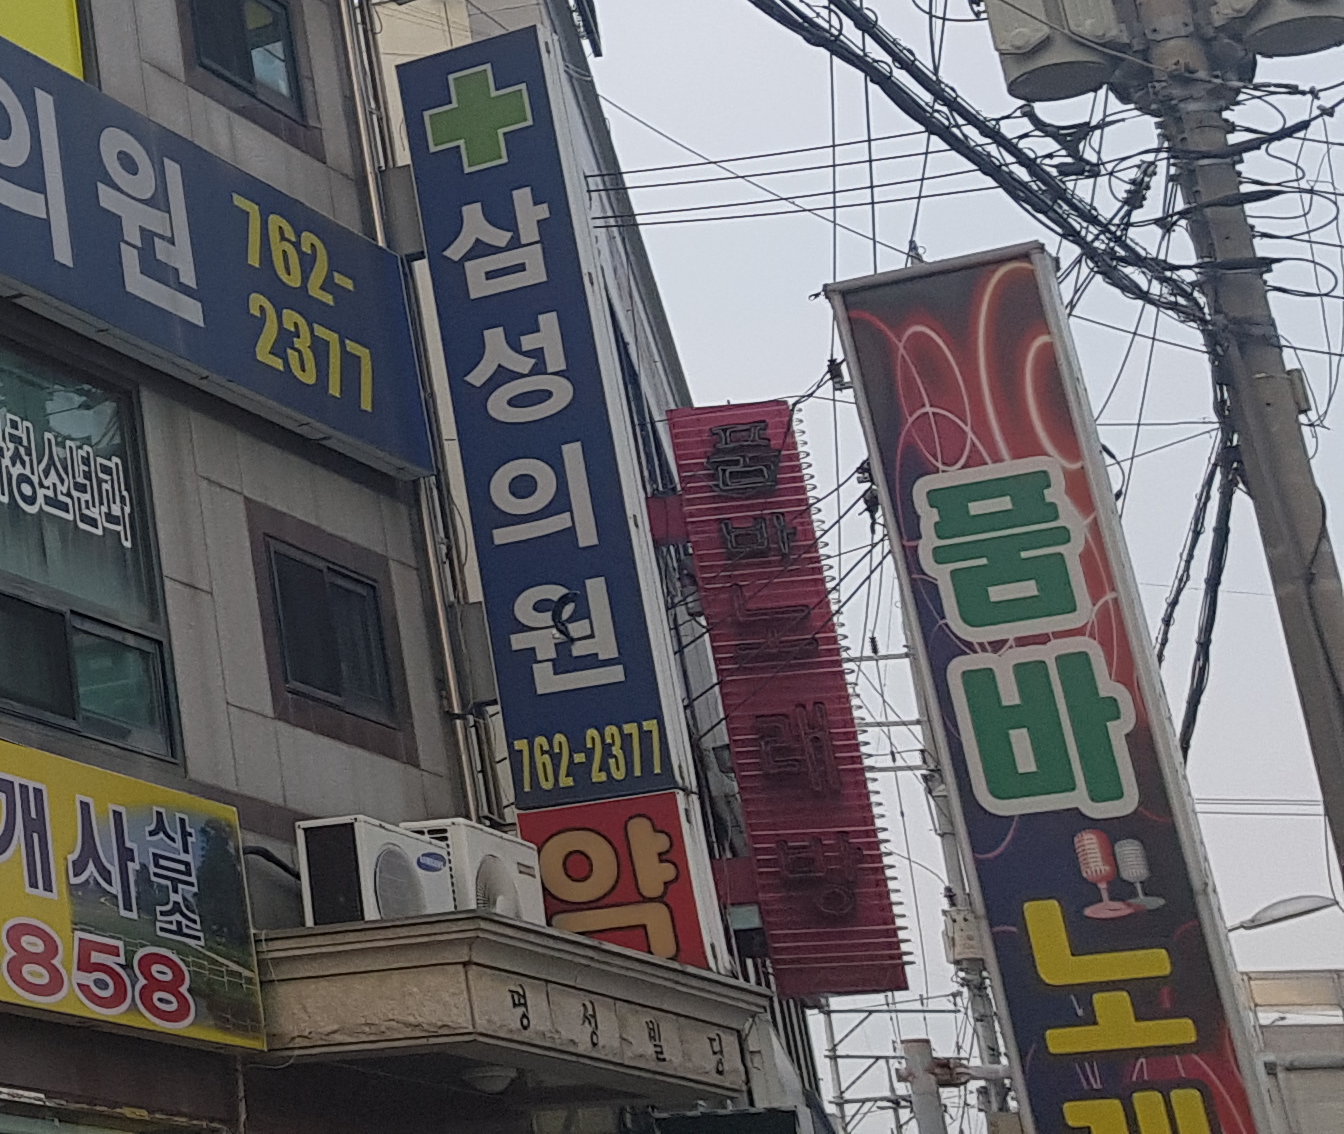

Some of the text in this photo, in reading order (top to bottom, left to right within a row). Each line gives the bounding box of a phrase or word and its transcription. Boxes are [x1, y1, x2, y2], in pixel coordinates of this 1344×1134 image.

[231, 190, 355, 307] 762-
[247, 293, 373, 414] 2377
[443, 188, 626, 695] 삼성의원
[912, 456, 1139, 819] 품바
[513, 718, 662, 794] 762-2377
[539, 813, 679, 961] 약
